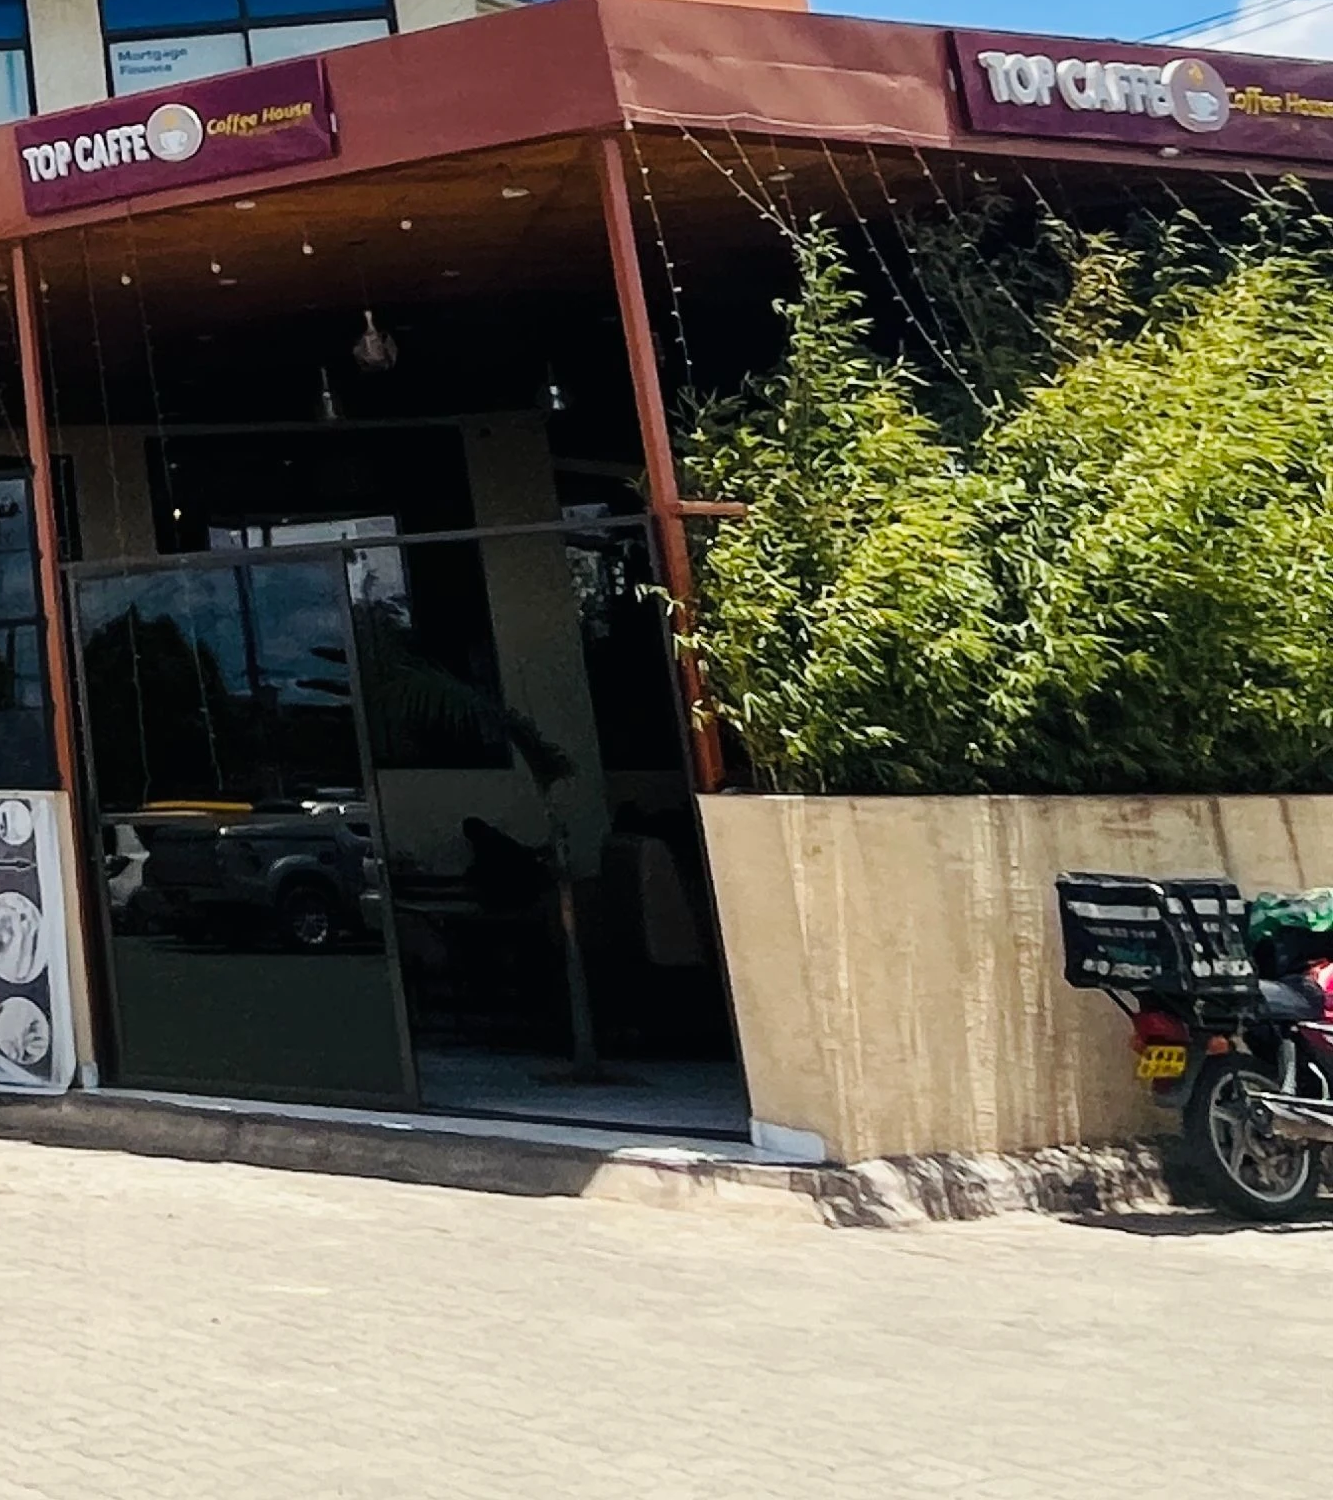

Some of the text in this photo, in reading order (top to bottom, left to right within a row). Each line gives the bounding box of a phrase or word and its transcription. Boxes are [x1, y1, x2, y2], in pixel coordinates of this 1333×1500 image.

[978, 51, 1056, 107] TOP
[1055, 58, 1174, 118] CAFFE
[22, 102, 313, 183] TOP CAFFE Coffee House
